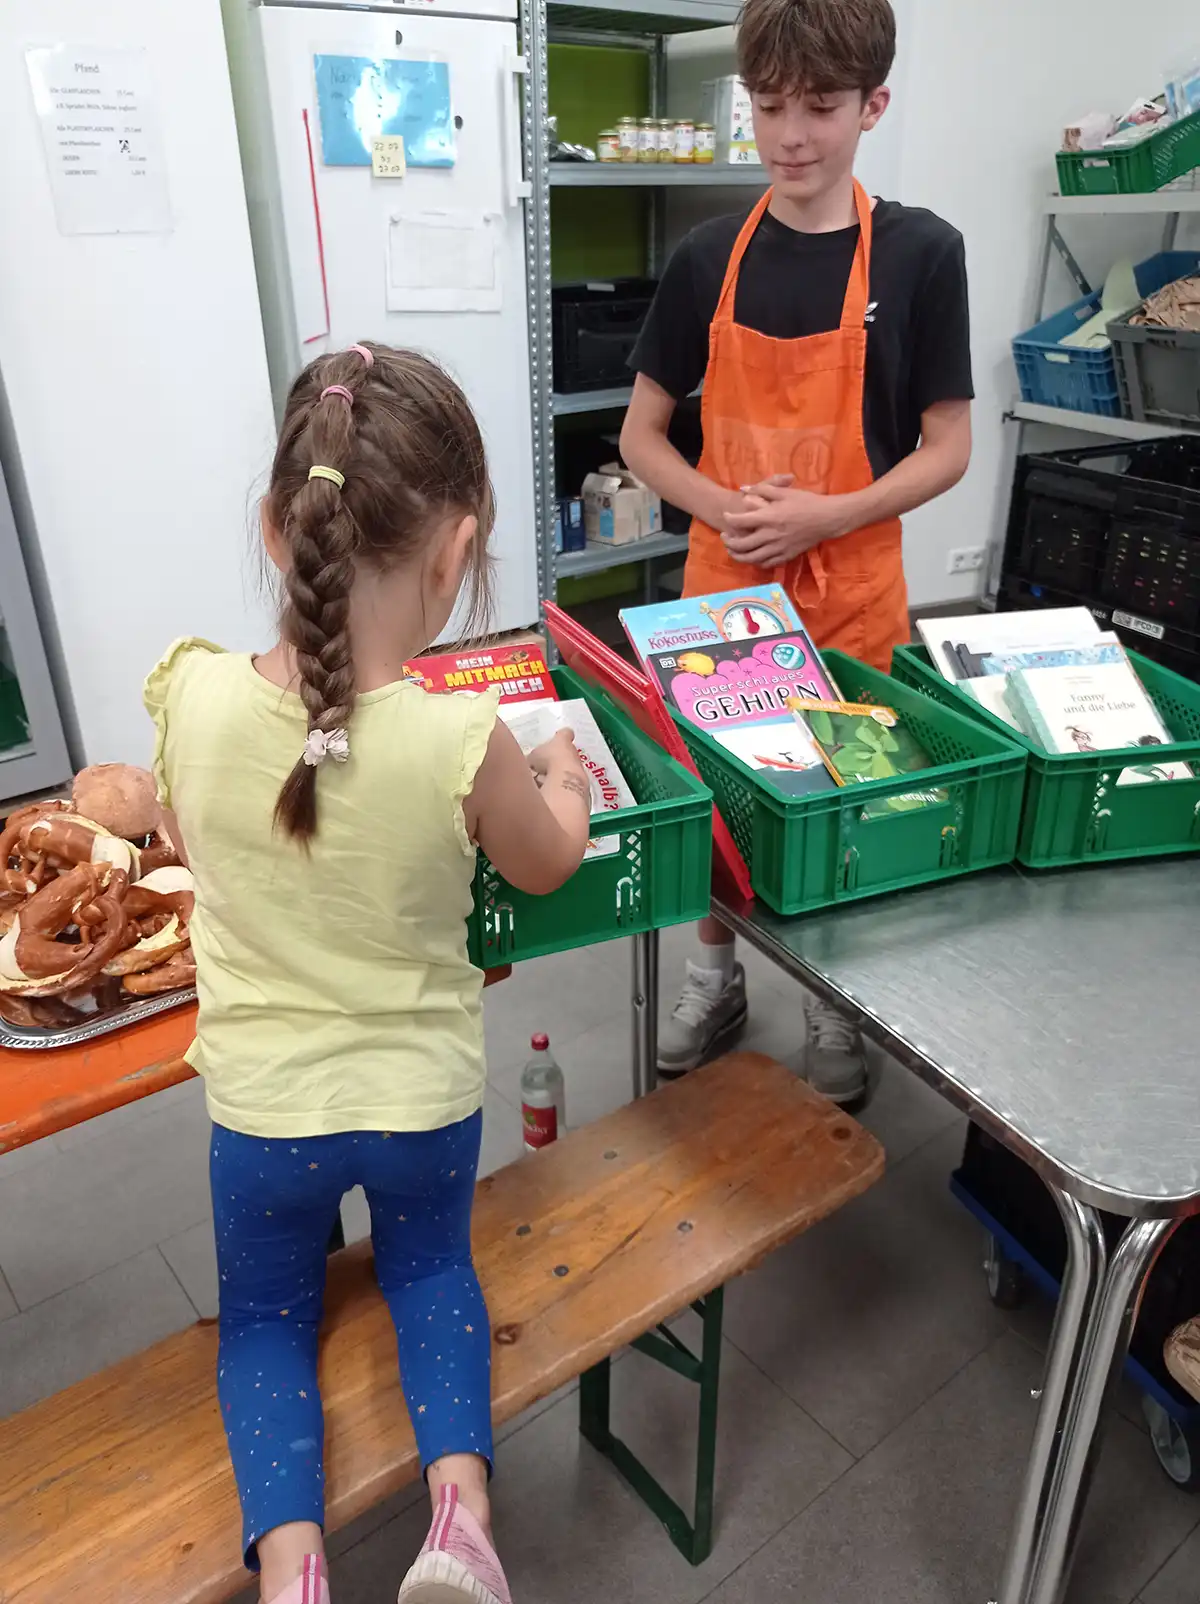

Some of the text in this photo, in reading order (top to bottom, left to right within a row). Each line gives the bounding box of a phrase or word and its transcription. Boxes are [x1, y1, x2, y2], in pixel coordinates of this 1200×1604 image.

[647, 629, 719, 650] Kokosnuss
[455, 655, 494, 670] MEIN
[443, 660, 546, 688] MITMACH
[499, 676, 545, 697] UCH
[1063, 701, 1136, 714] und die Liebe
[1070, 693, 1106, 703] Fanny
[577, 748, 619, 810] eshalb?
